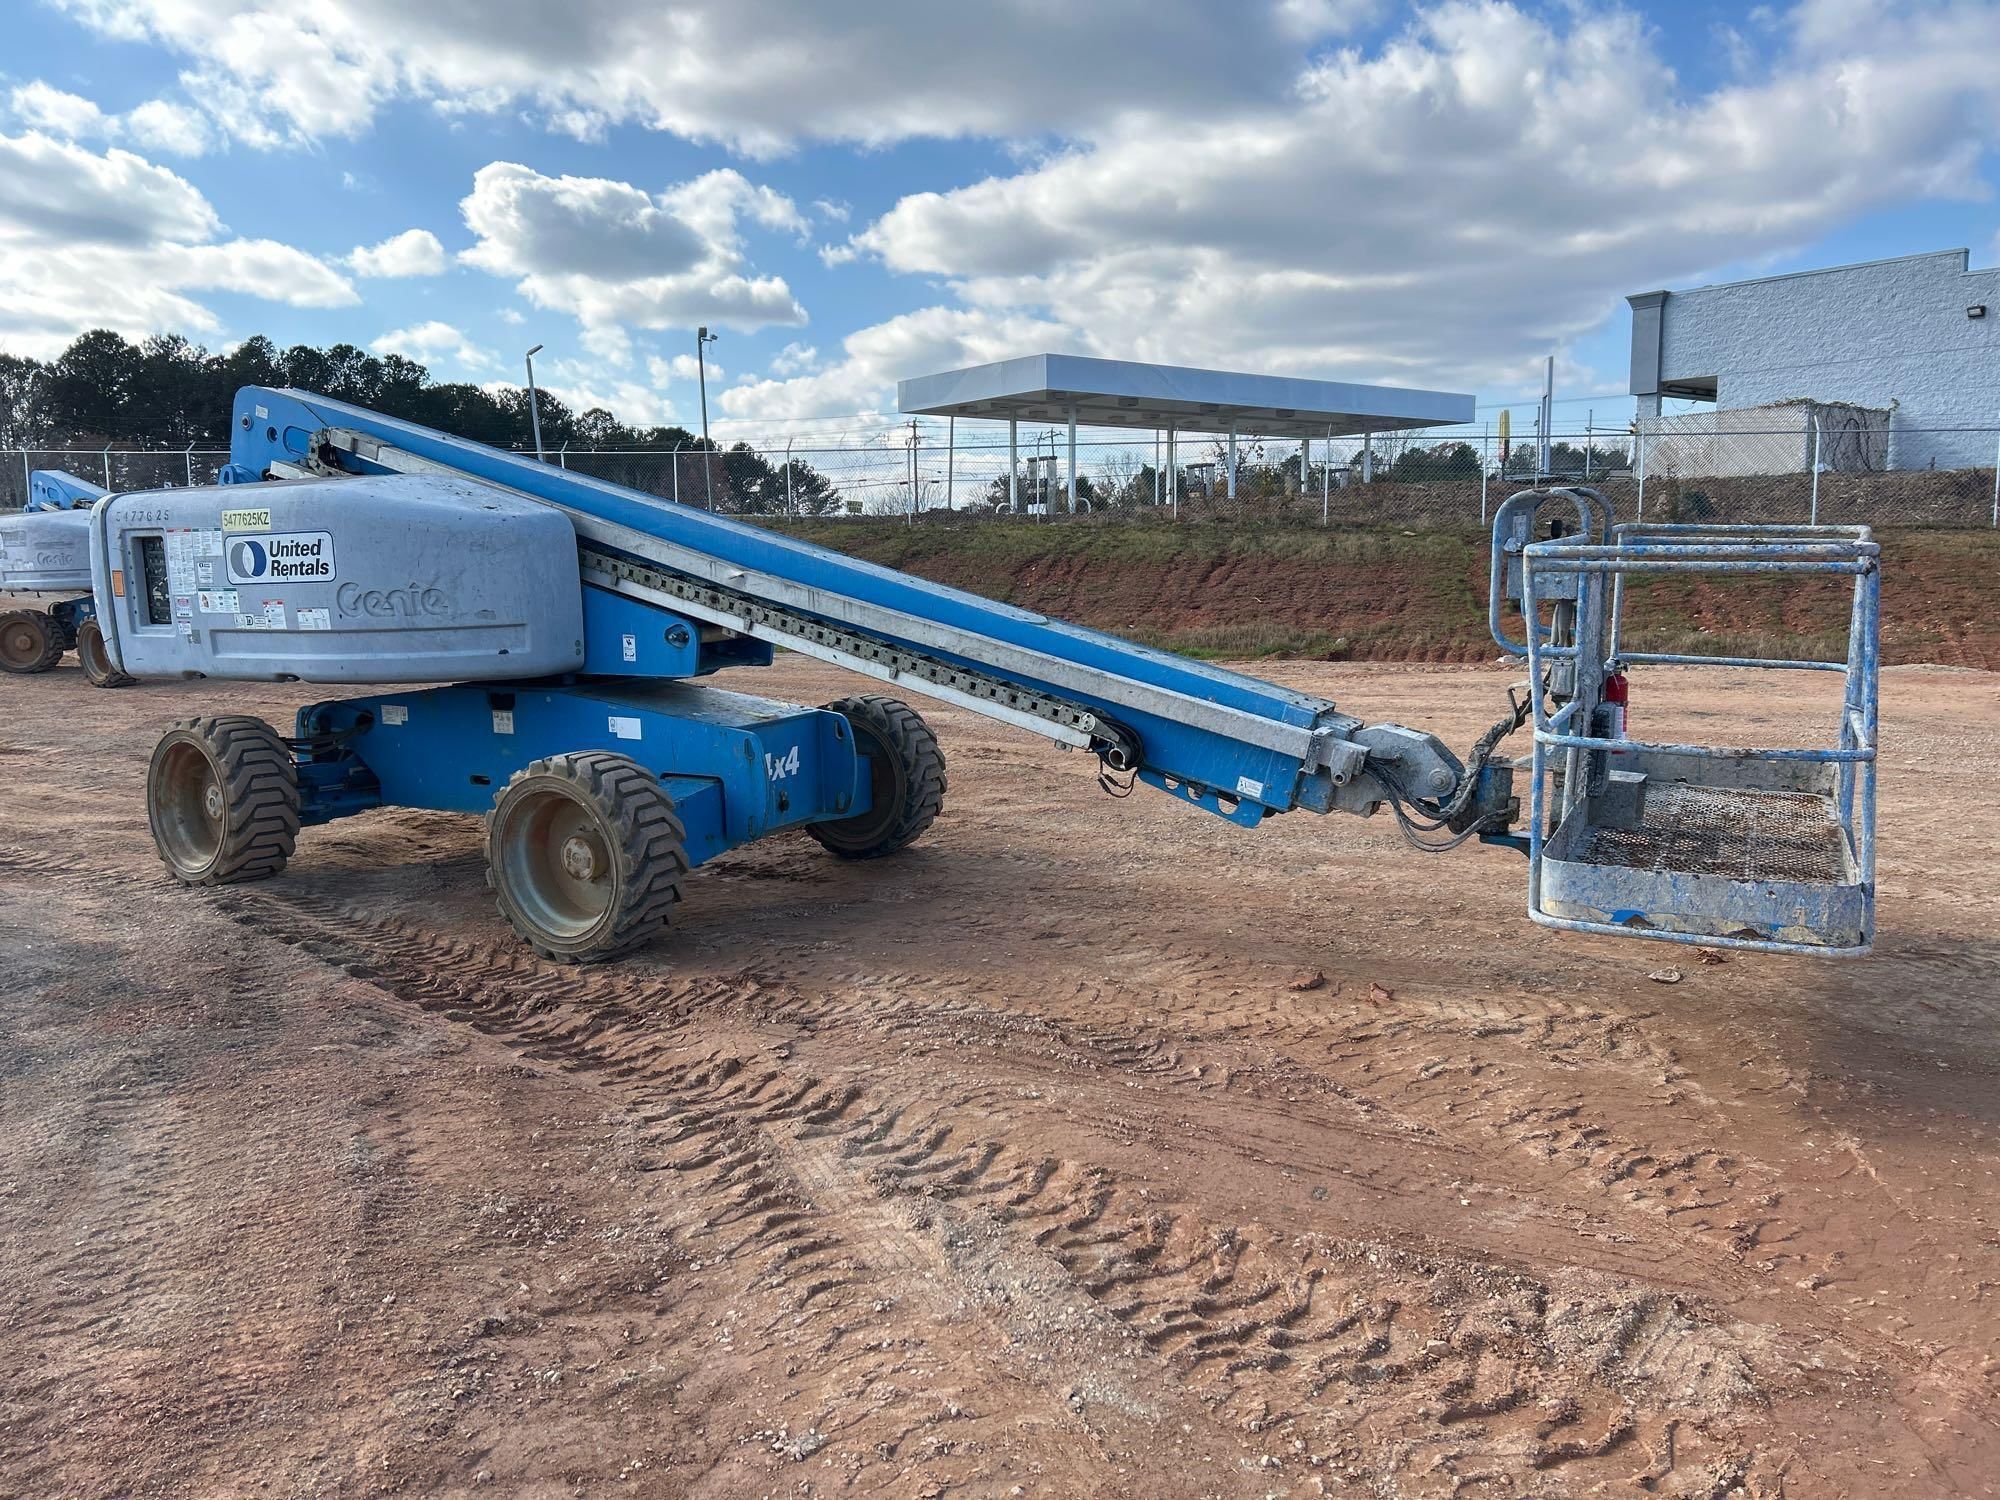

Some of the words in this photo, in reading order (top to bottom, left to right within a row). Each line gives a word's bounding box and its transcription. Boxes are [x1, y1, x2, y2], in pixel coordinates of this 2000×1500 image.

[223, 512, 270, 527] 5477625KZ
[269, 538, 322, 558] United
[270, 558, 330, 577] Rentals
[336, 581, 449, 617] Genie
